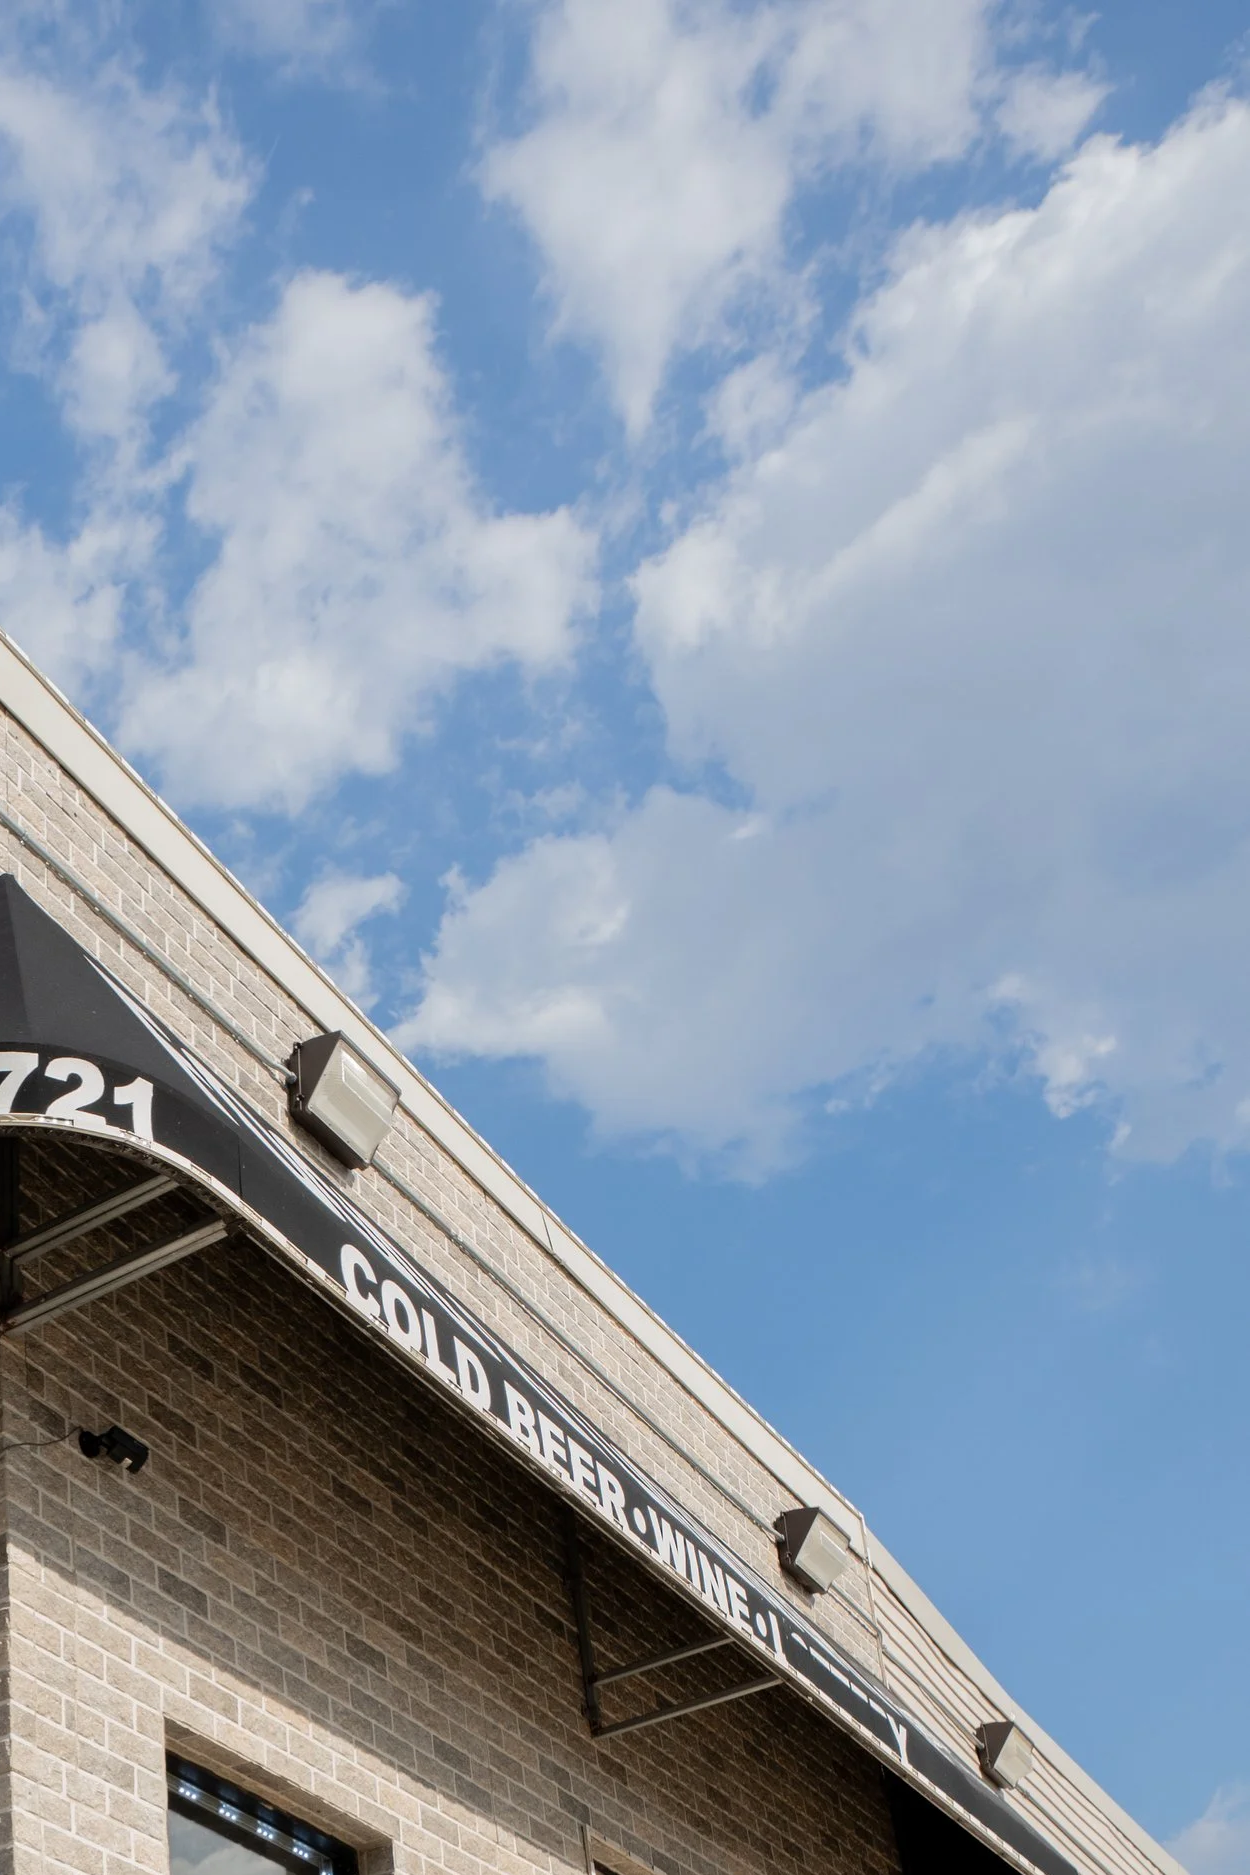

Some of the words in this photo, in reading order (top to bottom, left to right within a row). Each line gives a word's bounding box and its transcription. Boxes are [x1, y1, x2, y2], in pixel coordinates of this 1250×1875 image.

[341, 1244, 491, 1418] COLD
[506, 1387, 630, 1536] BEER
[650, 1506, 753, 1636] WINE
